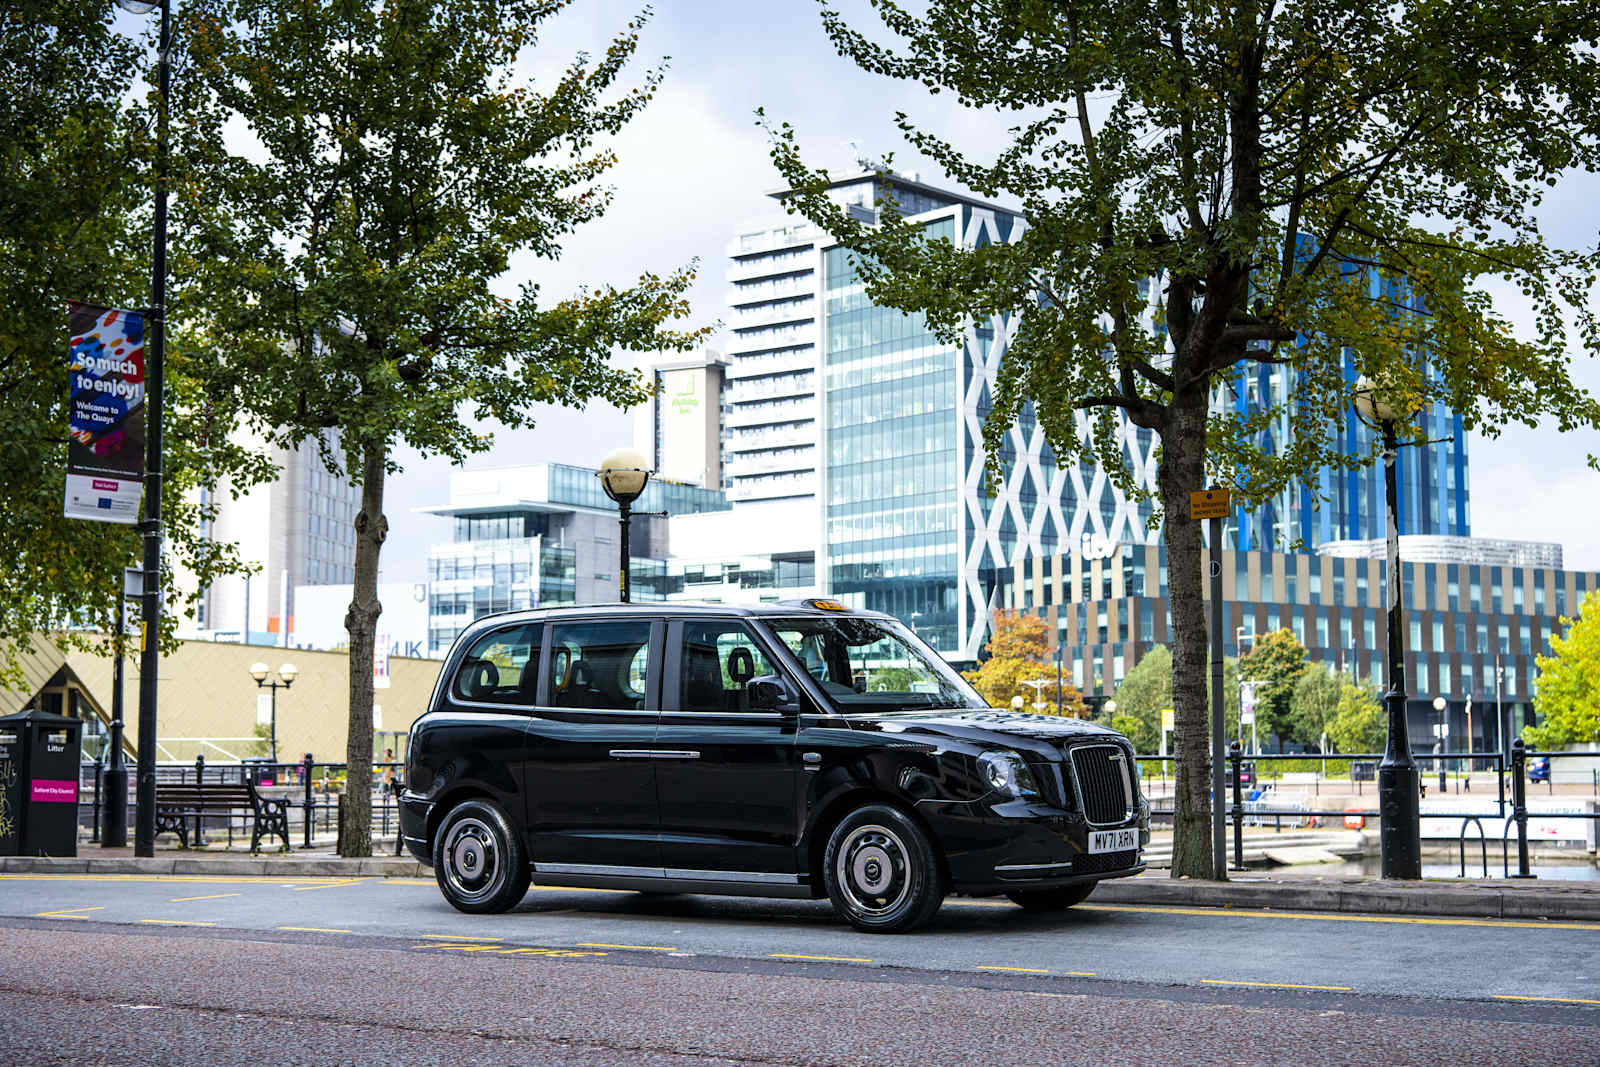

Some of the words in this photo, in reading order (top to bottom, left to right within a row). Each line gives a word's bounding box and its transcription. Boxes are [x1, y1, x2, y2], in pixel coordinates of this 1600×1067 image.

[77, 352, 95, 370] So
[97, 357, 137, 376] much
[77, 374, 93, 390] to
[94, 378, 139, 399] enjoy!
[76, 401, 109, 413] Welcome
[111, 406, 119, 415] to
[76, 410, 90, 421] The
[91, 413, 115, 424] Quays
[47, 744, 65, 752] Litter
[1095, 832, 1117, 849] MV71
[1118, 831, 1135, 848] XRN
